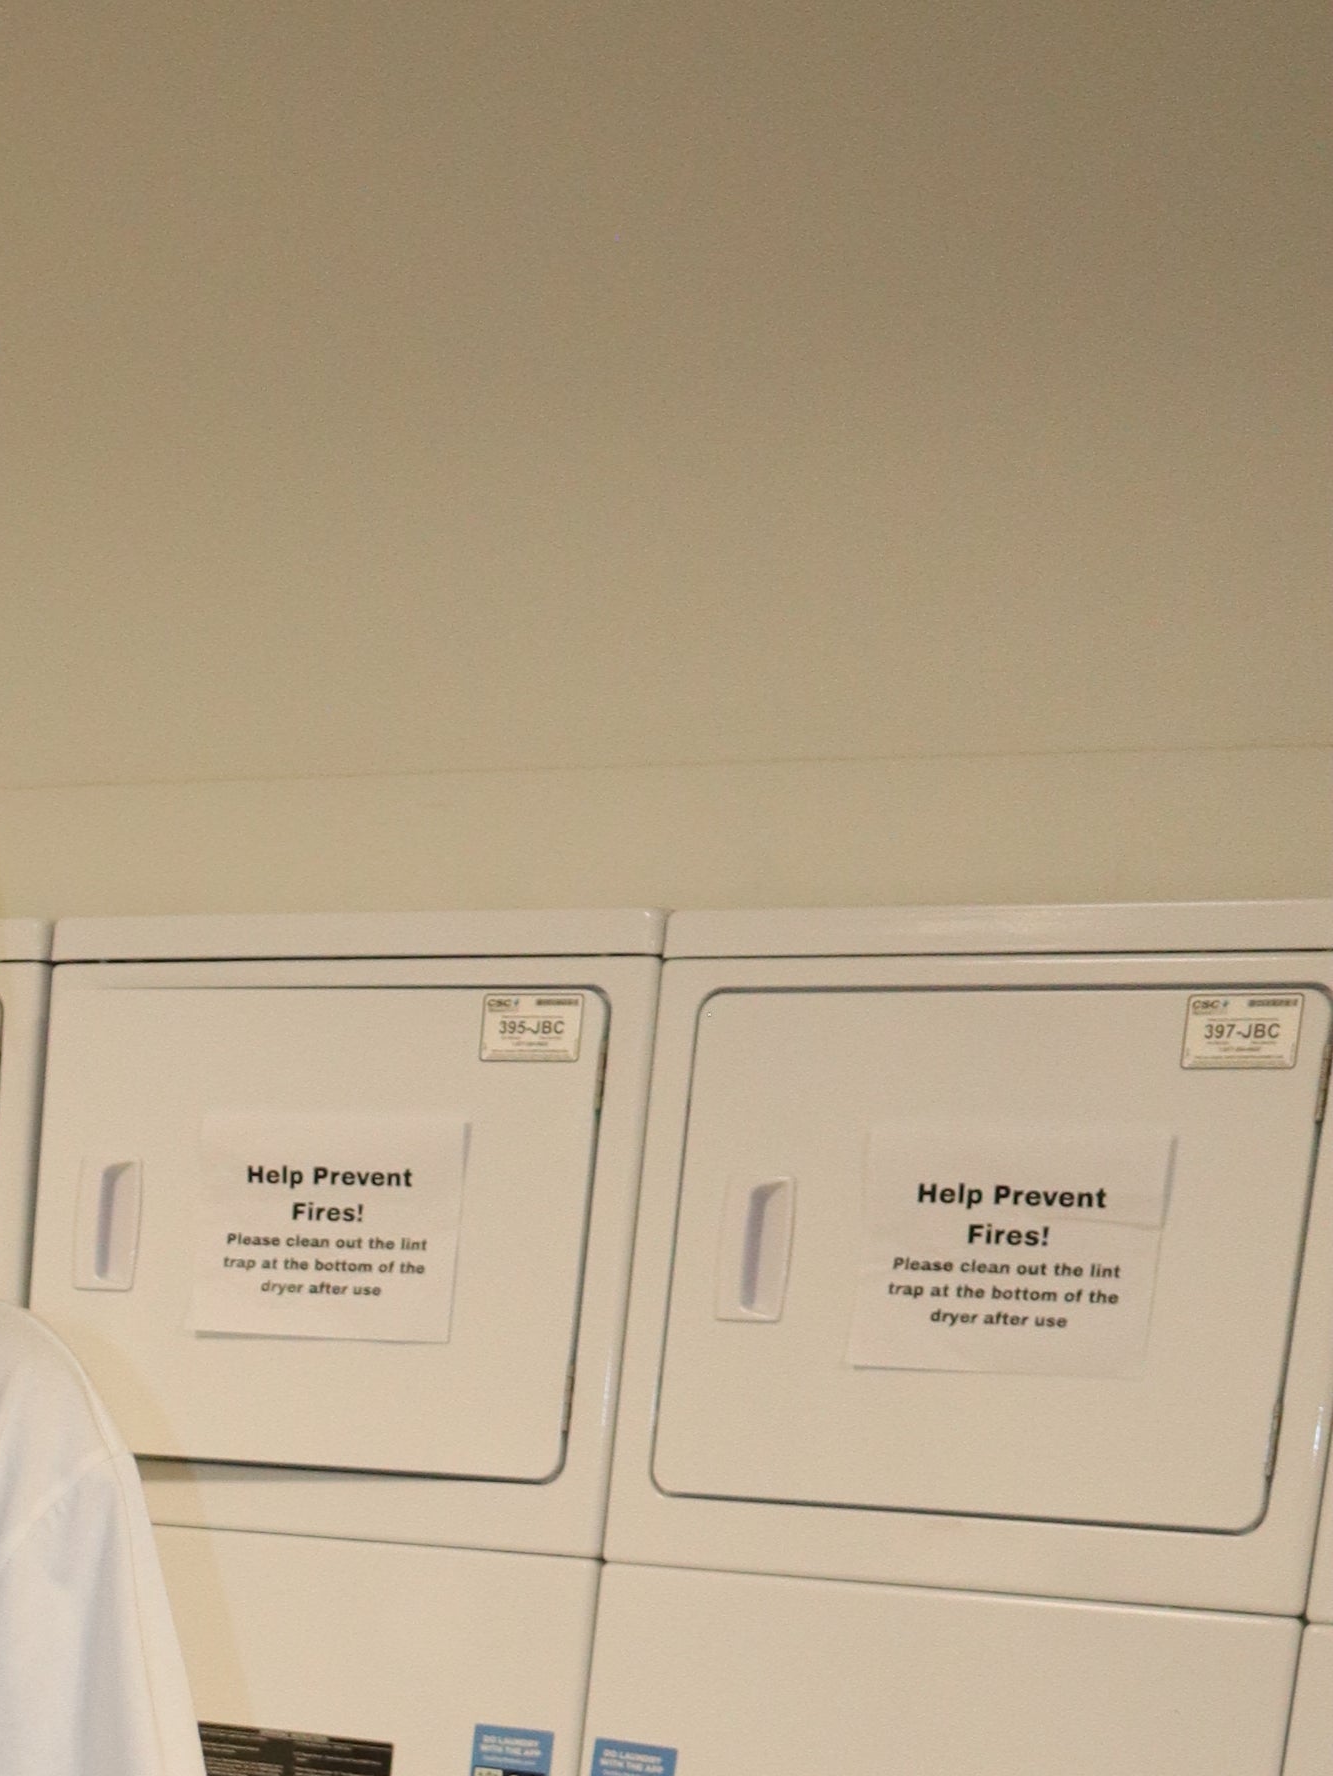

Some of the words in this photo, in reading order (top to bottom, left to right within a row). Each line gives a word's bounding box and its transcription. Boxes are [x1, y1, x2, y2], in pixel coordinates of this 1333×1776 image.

[498, 1020, 565, 1035] 395-JBC
[1204, 1023, 1281, 1039] 397-JBC
[247, 1165, 304, 1189] Help
[313, 1166, 413, 1188] Prevent
[917, 1183, 983, 1210] Help
[993, 1185, 1107, 1209] Prevent
[291, 1202, 364, 1222] Fires!
[226, 1233, 280, 1247] Please
[285, 1235, 329, 1248] clean
[336, 1238, 362, 1249] out
[369, 1238, 395, 1251] the
[401, 1238, 428, 1251] lint
[967, 1224, 1050, 1246] Fires!
[223, 1256, 256, 1271] trap
[261, 1258, 278, 1270] at
[284, 1258, 309, 1271] the
[314, 1259, 373, 1273] bottom
[378, 1261, 395, 1274] of
[400, 1262, 426, 1275] the
[892, 1257, 954, 1273] Please
[960, 1259, 1011, 1275] clean
[1016, 1263, 1047, 1276] out
[1054, 1263, 1084, 1278] the
[1090, 1263, 1121, 1279] lint
[260, 1280, 304, 1296] dryer
[308, 1281, 348, 1296] after
[352, 1285, 382, 1297] use
[888, 1283, 924, 1300] trap
[930, 1285, 949, 1298] at
[956, 1285, 985, 1300] the
[991, 1286, 1058, 1302] bottom
[1064, 1289, 1083, 1303] of
[1089, 1290, 1120, 1305] the
[930, 1308, 978, 1327] dryer
[983, 1311, 1029, 1327] after
[1034, 1315, 1068, 1329] use
